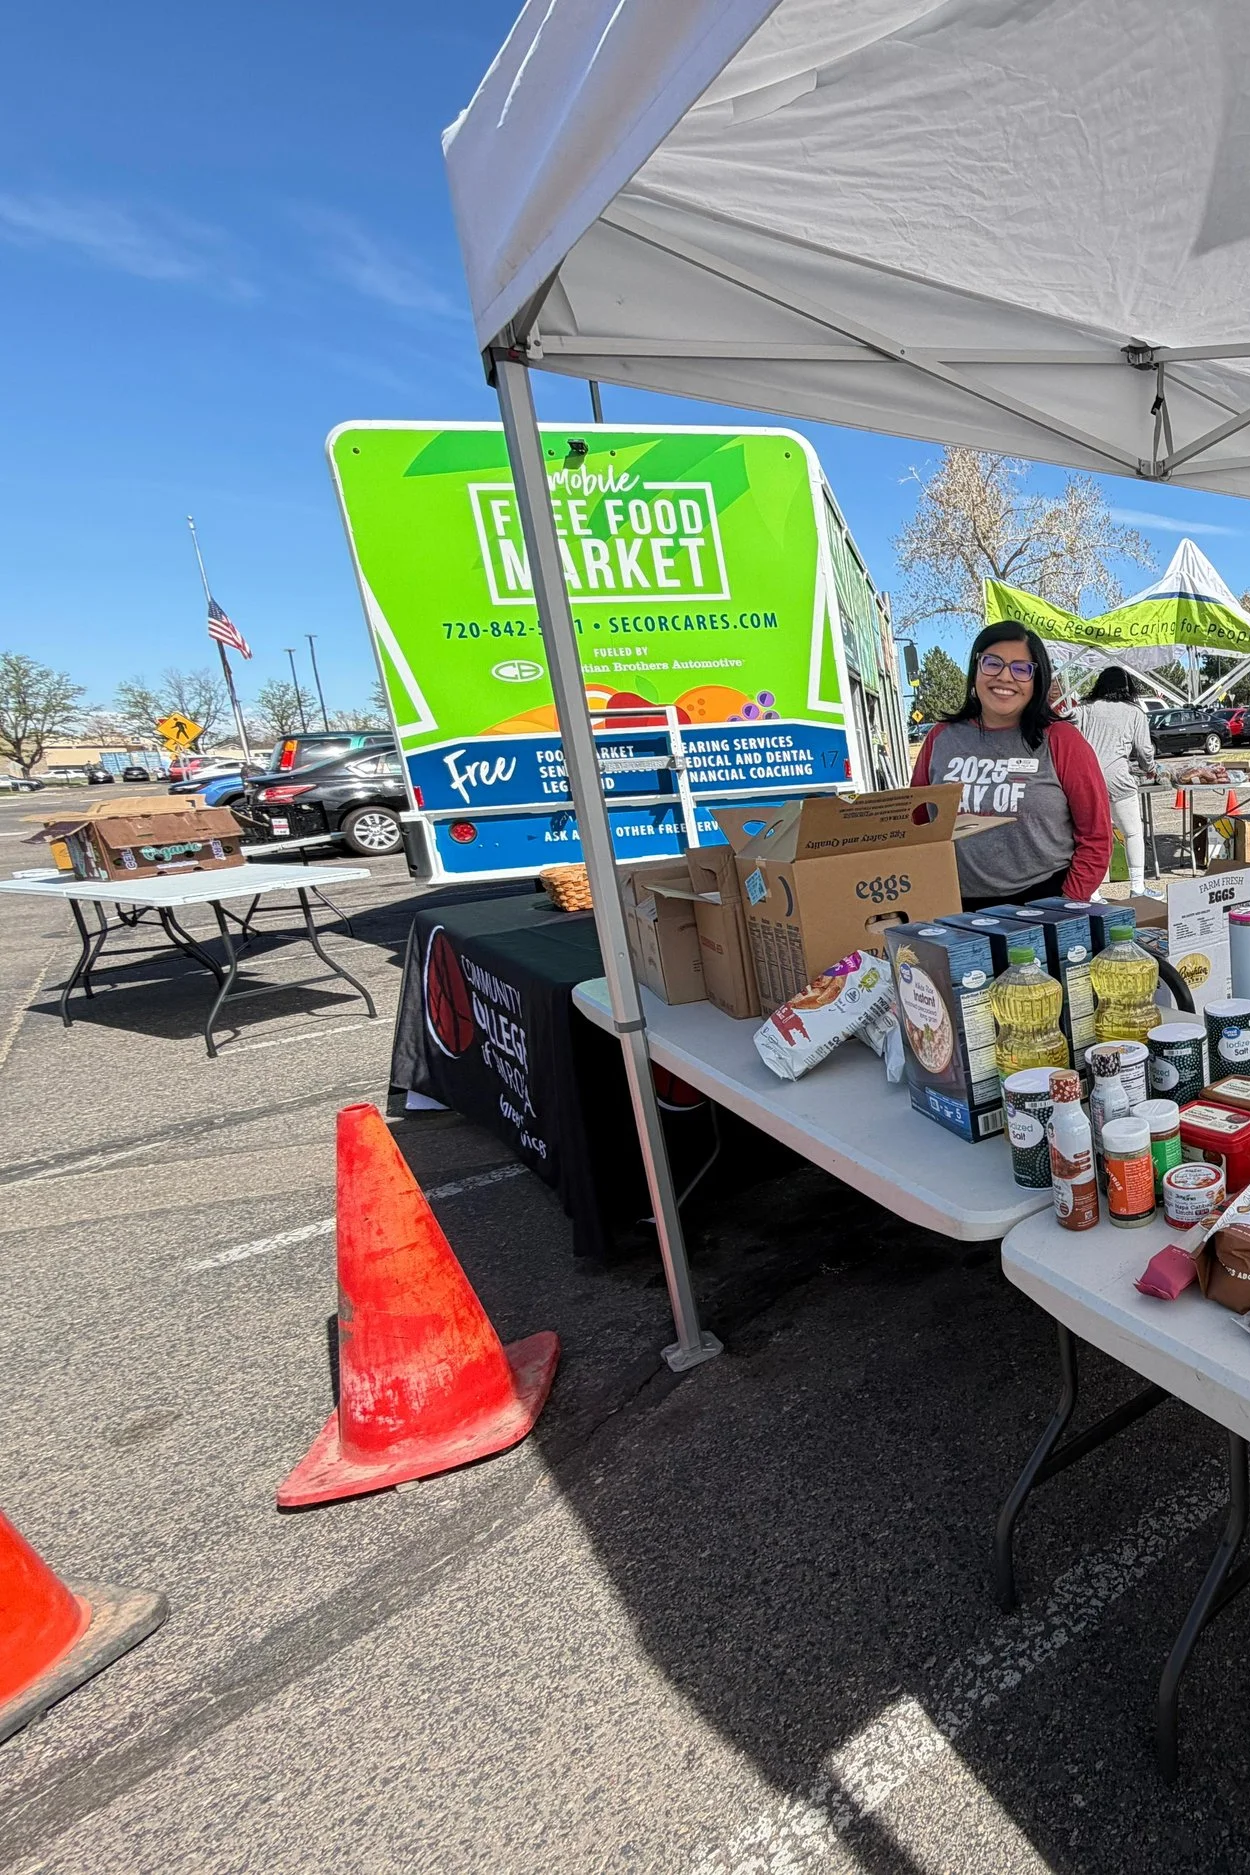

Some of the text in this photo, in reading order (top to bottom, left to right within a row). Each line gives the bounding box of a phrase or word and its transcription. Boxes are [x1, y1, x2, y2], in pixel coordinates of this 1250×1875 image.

[491, 499, 704, 536] FEE FOOD
[609, 612, 778, 634] SECORCARES.COM
[1006, 604, 1055, 632] Caring
[1130, 622, 1176, 637] Caring
[1180, 618, 1200, 633] for
[594, 647, 648, 657] FUELED BY
[613, 661, 669, 672] Brothers
[672, 658, 743, 669] Automotive
[682, 736, 794, 755] EARING SERVICES
[536, 750, 565, 763] FOO
[687, 749, 814, 769] EDICAL AND DENTAL
[443, 749, 517, 804] Free
[690, 763, 813, 783] NANCIAL COACHING
[943, 756, 1008, 783] 2025
[958, 783, 1026, 813] AY OF
[544, 831, 566, 842] ASK
[615, 822, 655, 838] OTHER
[659, 819, 687, 834] FREE
[805, 830, 906, 850] Egg Safety and Quality
[140, 842, 202, 861] Organic
[855, 874, 911, 903] eggs
[1199, 877, 1244, 894] FARM FRESH
[1209, 888, 1235, 904] EGGS
[913, 990, 936, 1008] Instant
[1234, 1047, 1249, 1056] Salt
[1012, 1131, 1026, 1141] Salt
